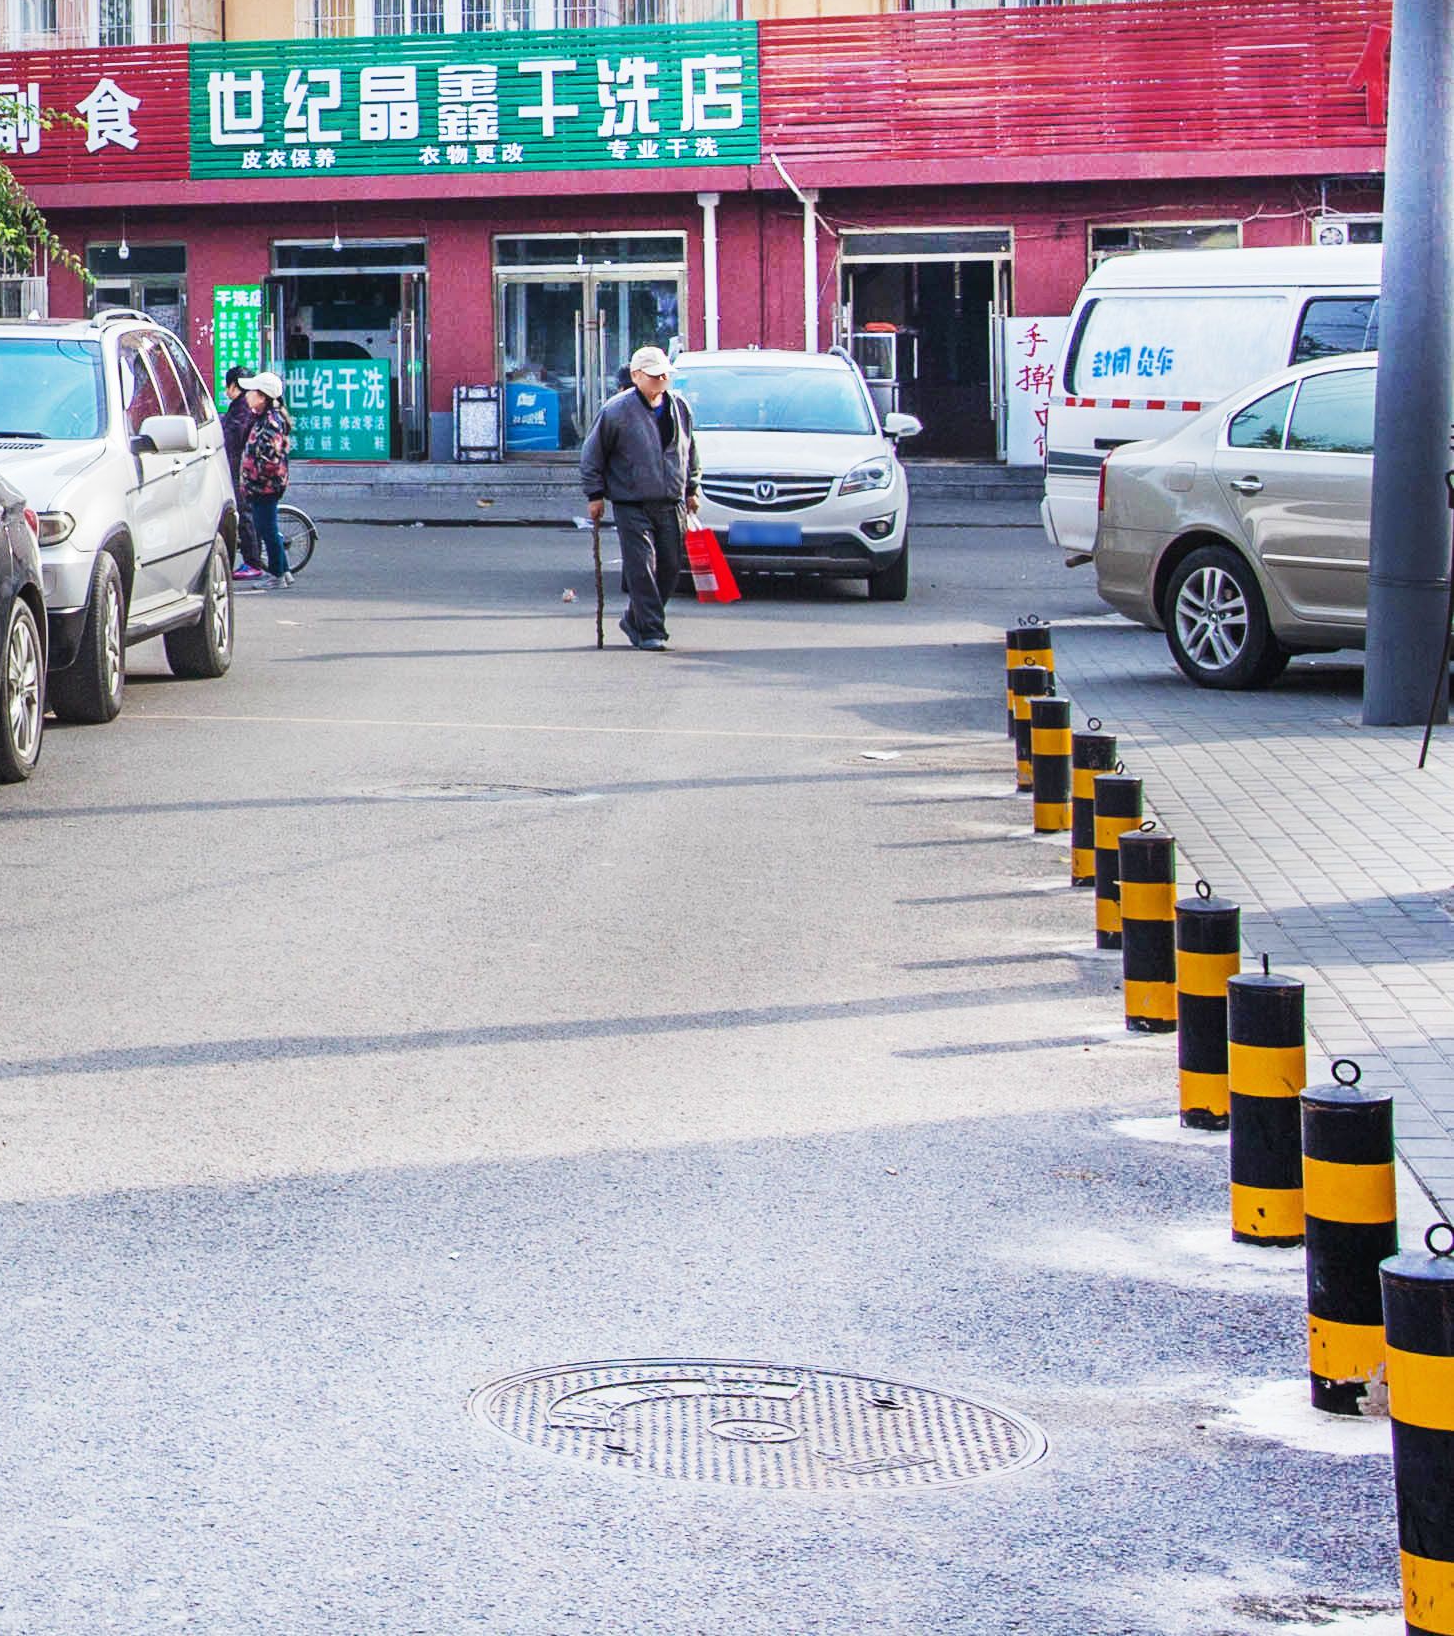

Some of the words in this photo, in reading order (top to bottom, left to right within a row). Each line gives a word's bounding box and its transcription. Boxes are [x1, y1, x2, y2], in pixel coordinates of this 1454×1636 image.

[207, 53, 745, 147] 世纪晶鑫干洗店
[241, 148, 337, 171] 皮衣保养
[418, 144, 525, 166] 衣物更改
[606, 137, 719, 160] 专业干洗
[286, 367, 385, 410] 世纪干洗
